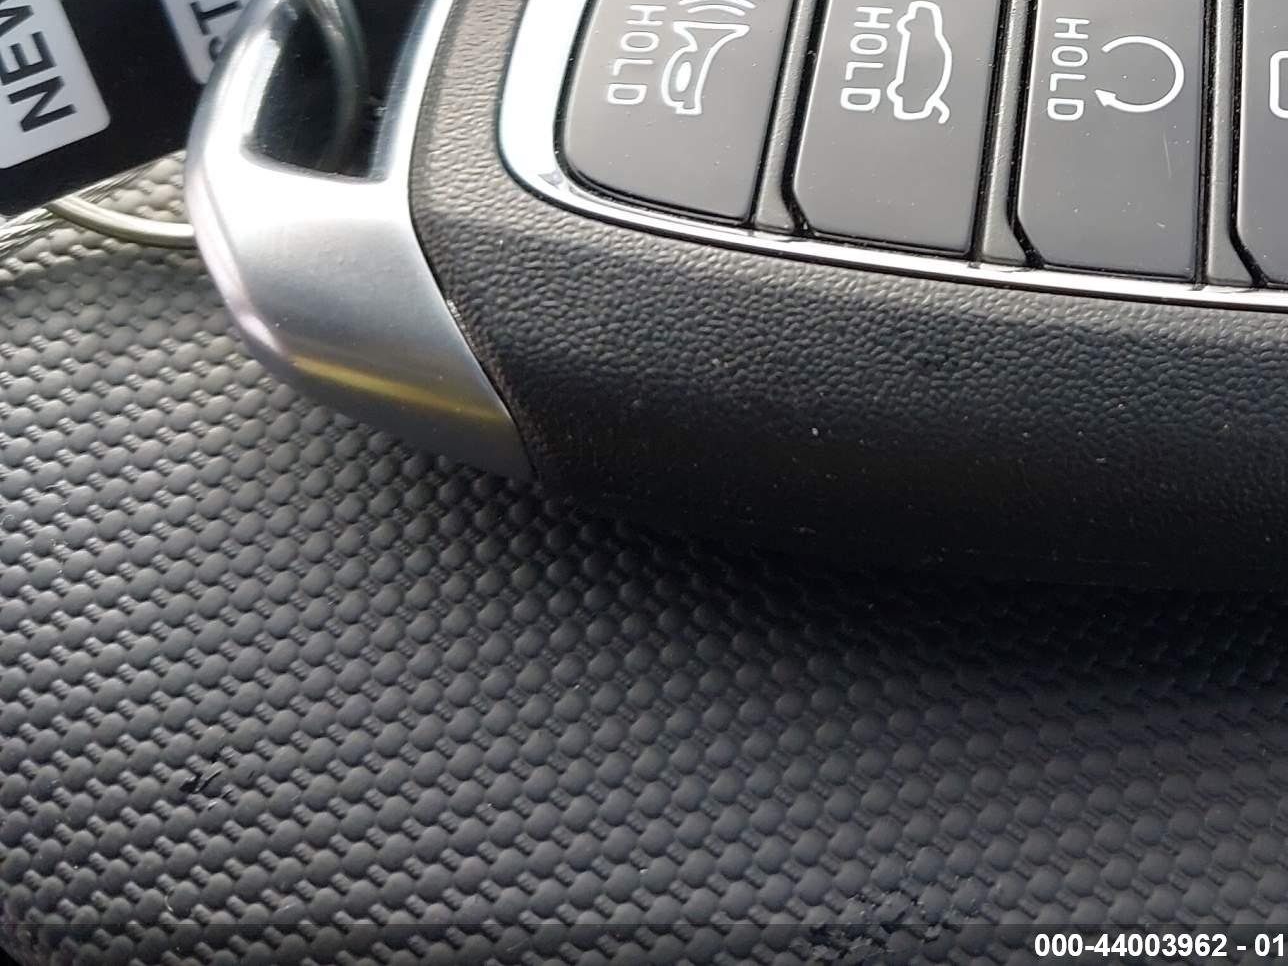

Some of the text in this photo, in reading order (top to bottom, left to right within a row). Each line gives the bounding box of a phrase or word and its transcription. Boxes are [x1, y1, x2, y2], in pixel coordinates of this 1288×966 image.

[606, 4, 667, 106] HOLD
[840, 6, 894, 111] HOLD
[1046, 17, 1091, 122] HOLD
